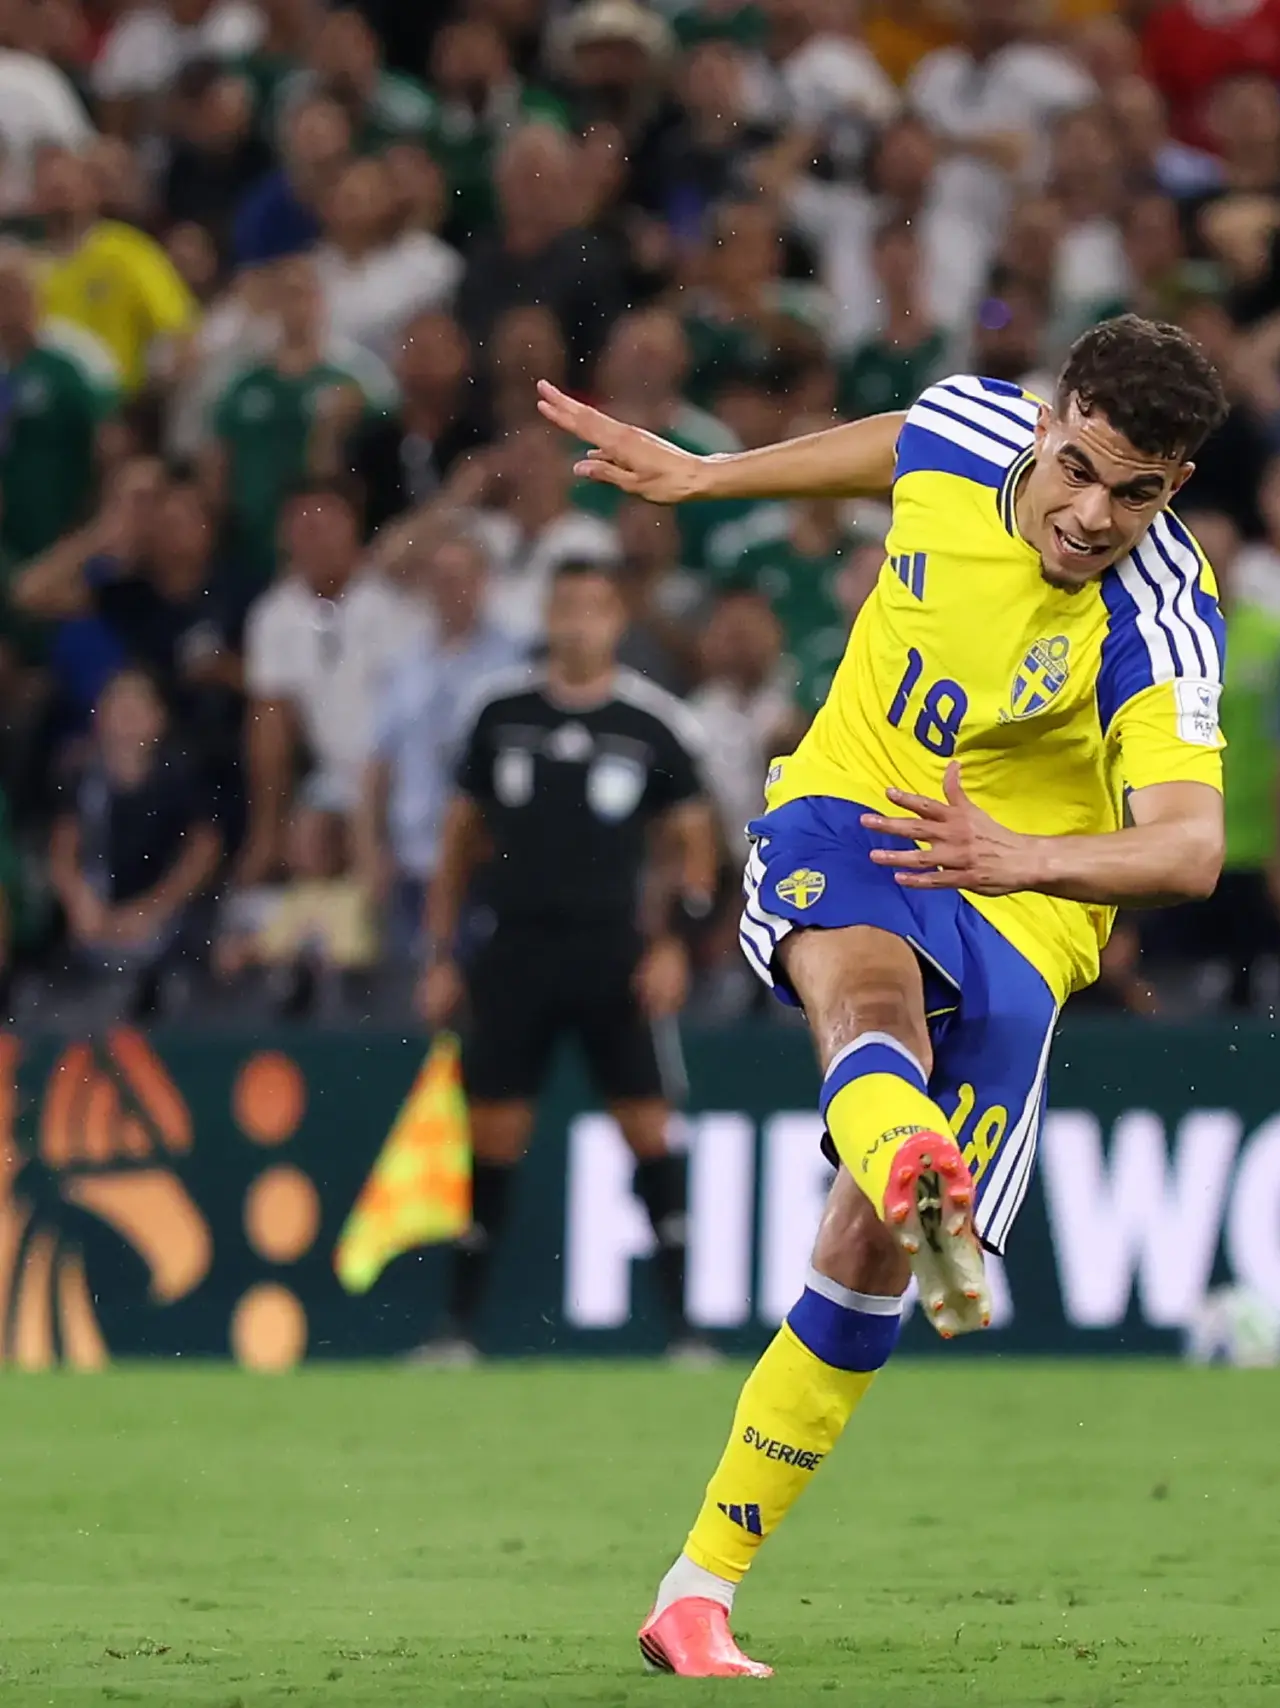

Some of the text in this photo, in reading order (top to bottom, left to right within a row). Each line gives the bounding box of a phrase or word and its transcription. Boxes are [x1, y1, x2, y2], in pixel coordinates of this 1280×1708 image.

[886, 646, 969, 758] 18
[948, 1082, 1008, 1186] 18
[743, 1426, 824, 1471] SVERIGE
